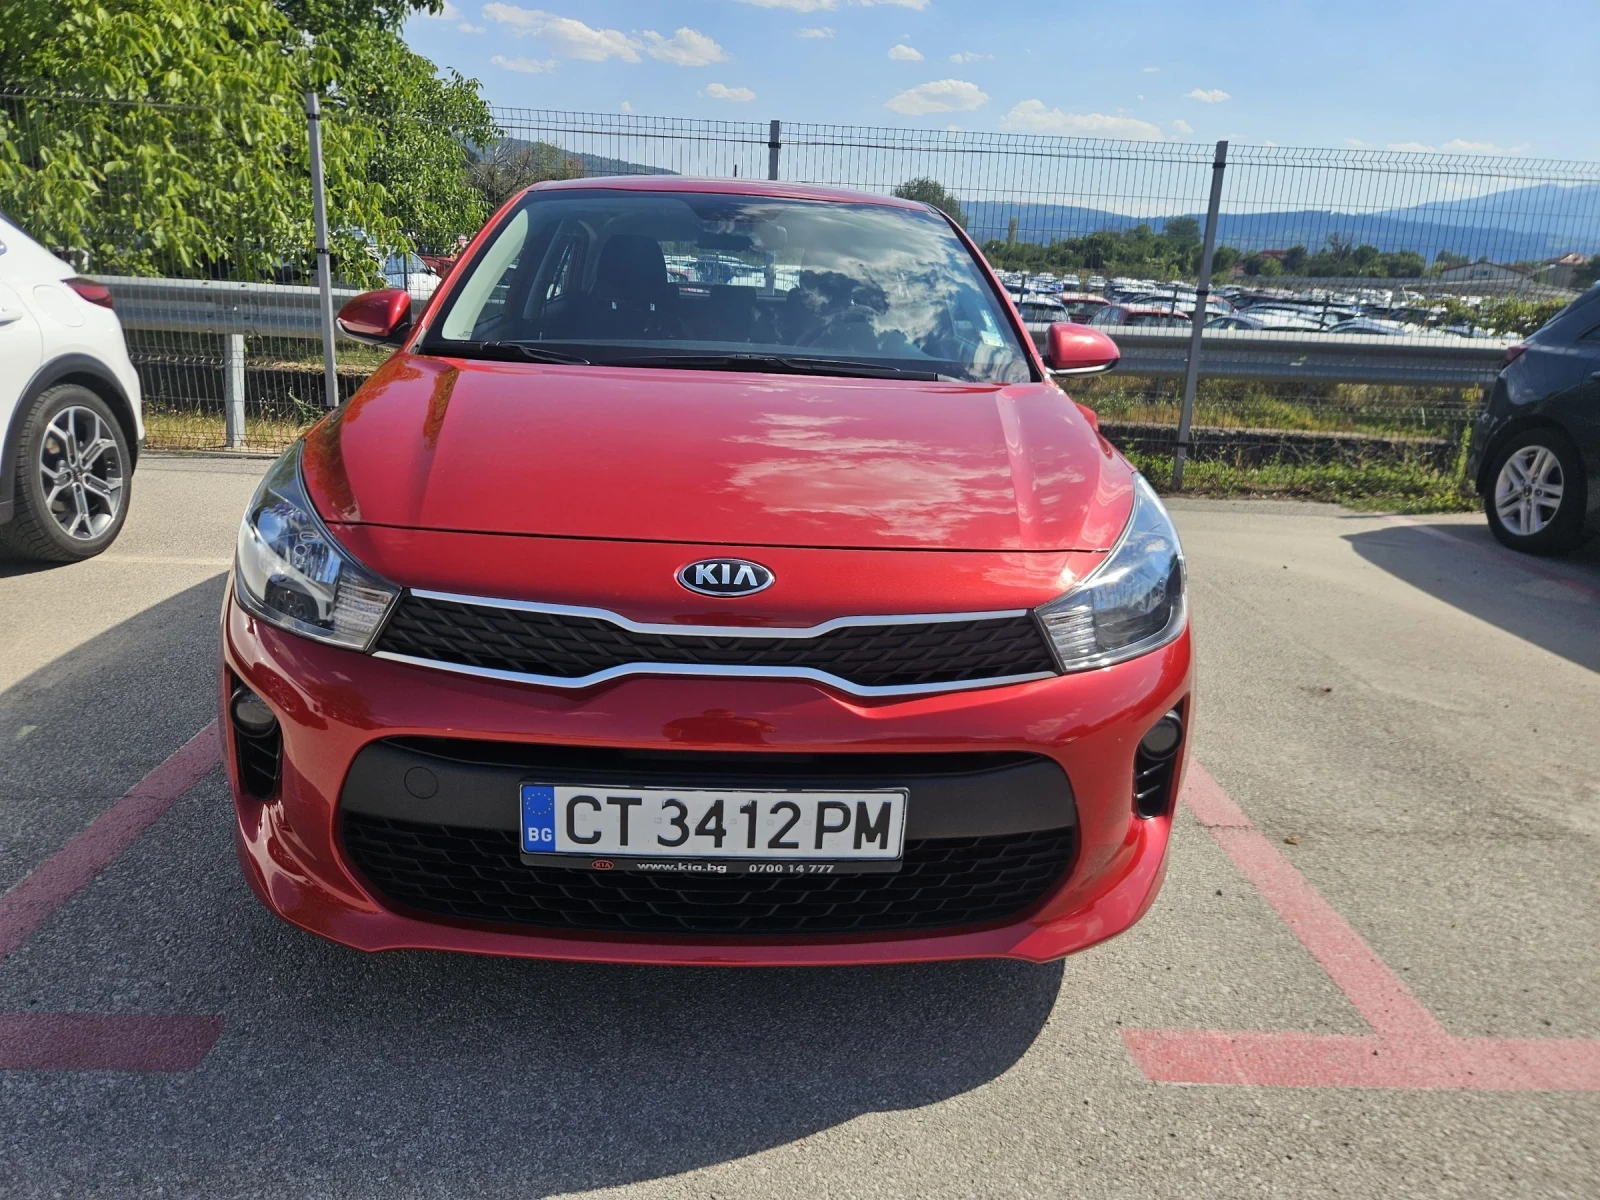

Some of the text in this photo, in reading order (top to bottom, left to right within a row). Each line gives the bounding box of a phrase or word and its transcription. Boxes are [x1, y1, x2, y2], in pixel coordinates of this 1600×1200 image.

[695, 564, 758, 586] KIA
[566, 795, 893, 850] CT 3412 PM
[527, 828, 552, 842] BG
[637, 861, 835, 874] www.kia.bg 0700 14 777
